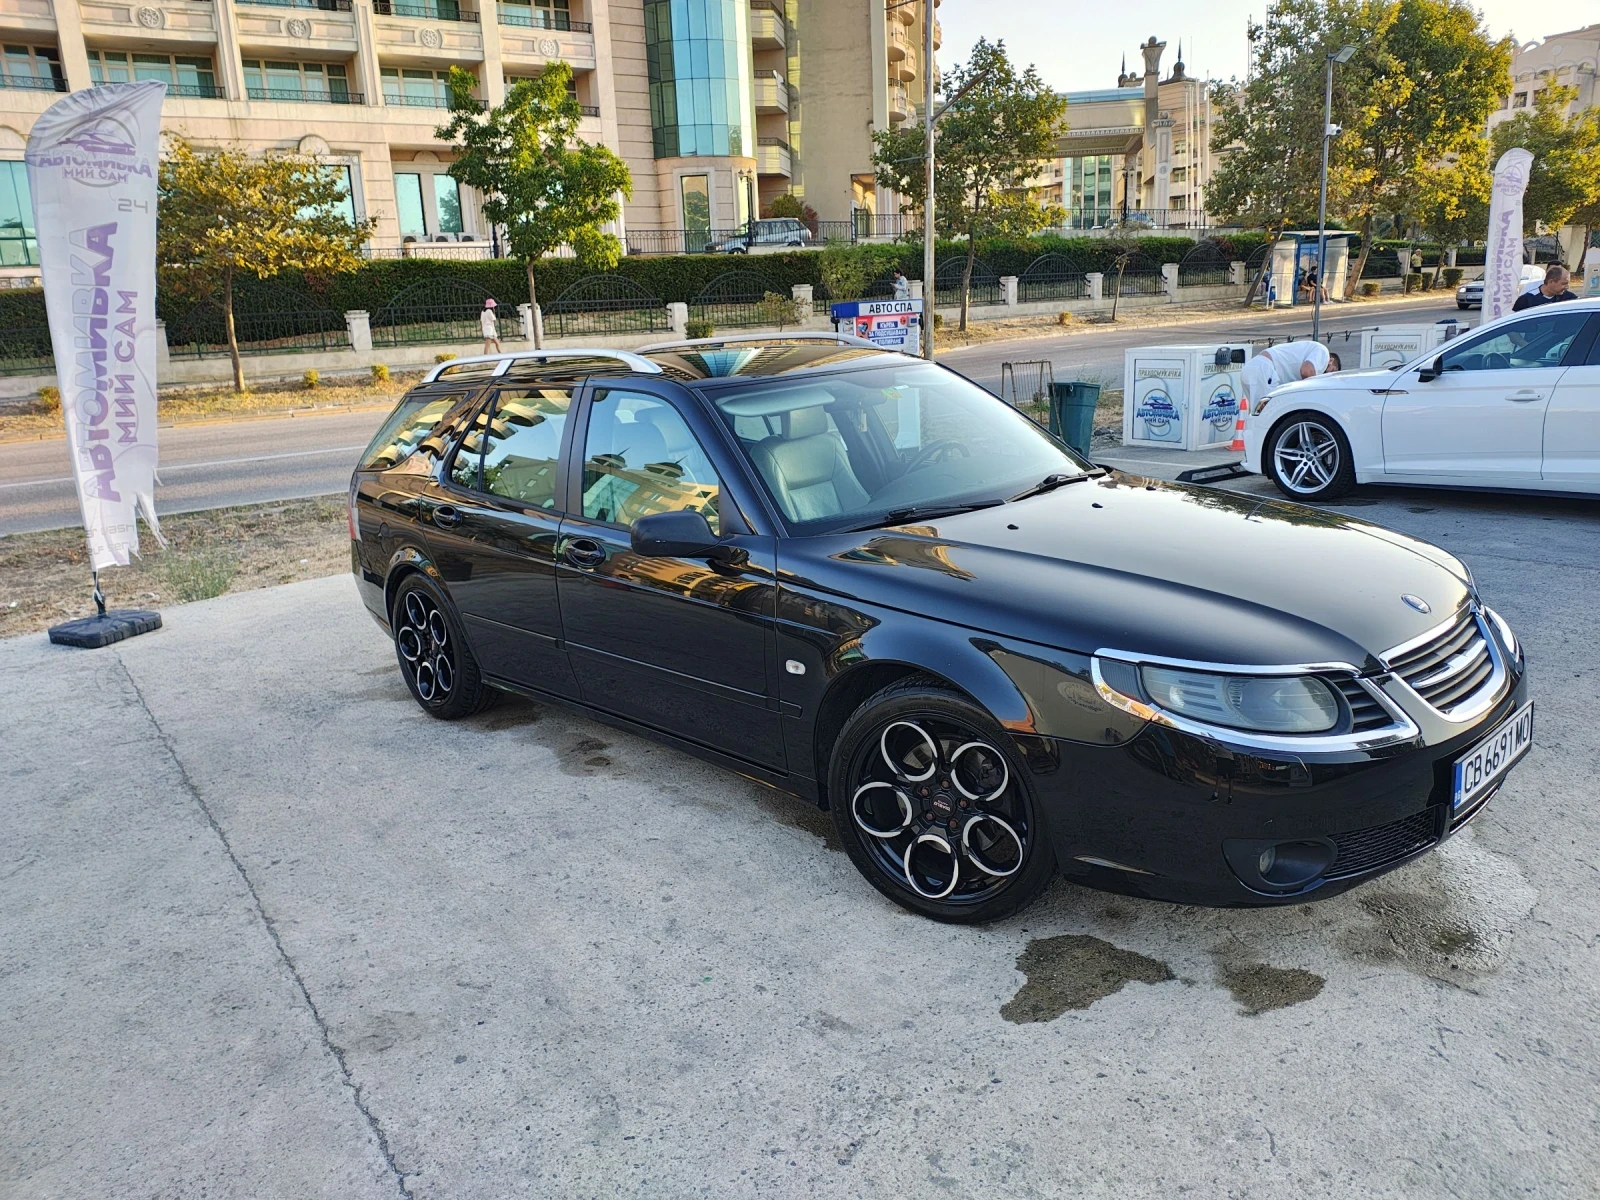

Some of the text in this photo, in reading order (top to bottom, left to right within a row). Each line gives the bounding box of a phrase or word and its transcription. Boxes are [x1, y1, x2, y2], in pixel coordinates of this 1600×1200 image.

[63, 165, 128, 183] МИЙ САМ
[117, 198, 148, 214] 24
[1488, 209, 1515, 320] ВТОМИВКА
[1503, 238, 1518, 269] САМ
[869, 302, 913, 313] АВТО СПА
[69, 221, 121, 503] АВТОМИВКА
[108, 290, 138, 443] МИЙ САМ
[1138, 369, 1182, 378] ПРАХОСМУКАЧКА
[1136, 408, 1180, 421] АВТОМИВКА
[1464, 711, 1530, 793] CB 6691 MO
